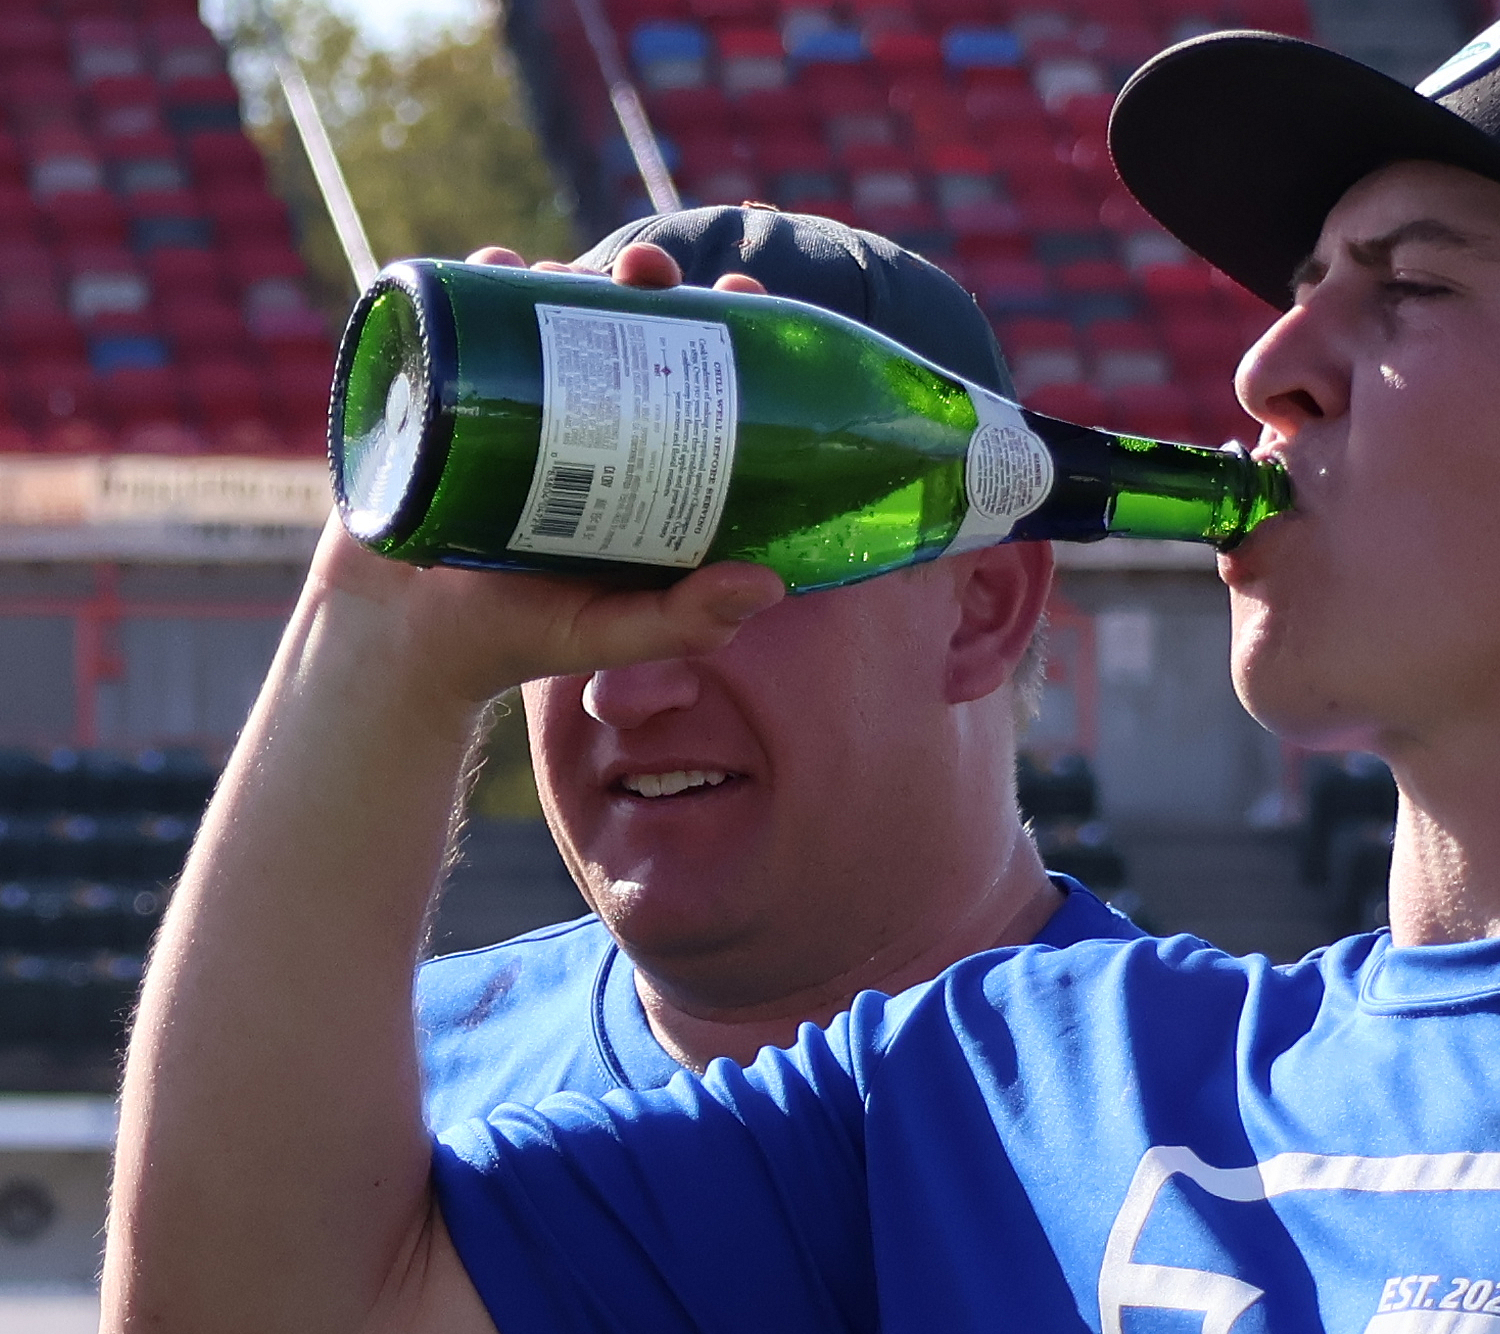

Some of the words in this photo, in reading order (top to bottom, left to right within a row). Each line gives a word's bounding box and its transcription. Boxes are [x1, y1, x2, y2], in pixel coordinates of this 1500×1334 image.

[714, 362, 723, 395] CHILL
[716, 399, 724, 432] WELL
[694, 488, 714, 535] SERVING
[1377, 1274, 1440, 1313] EST.
